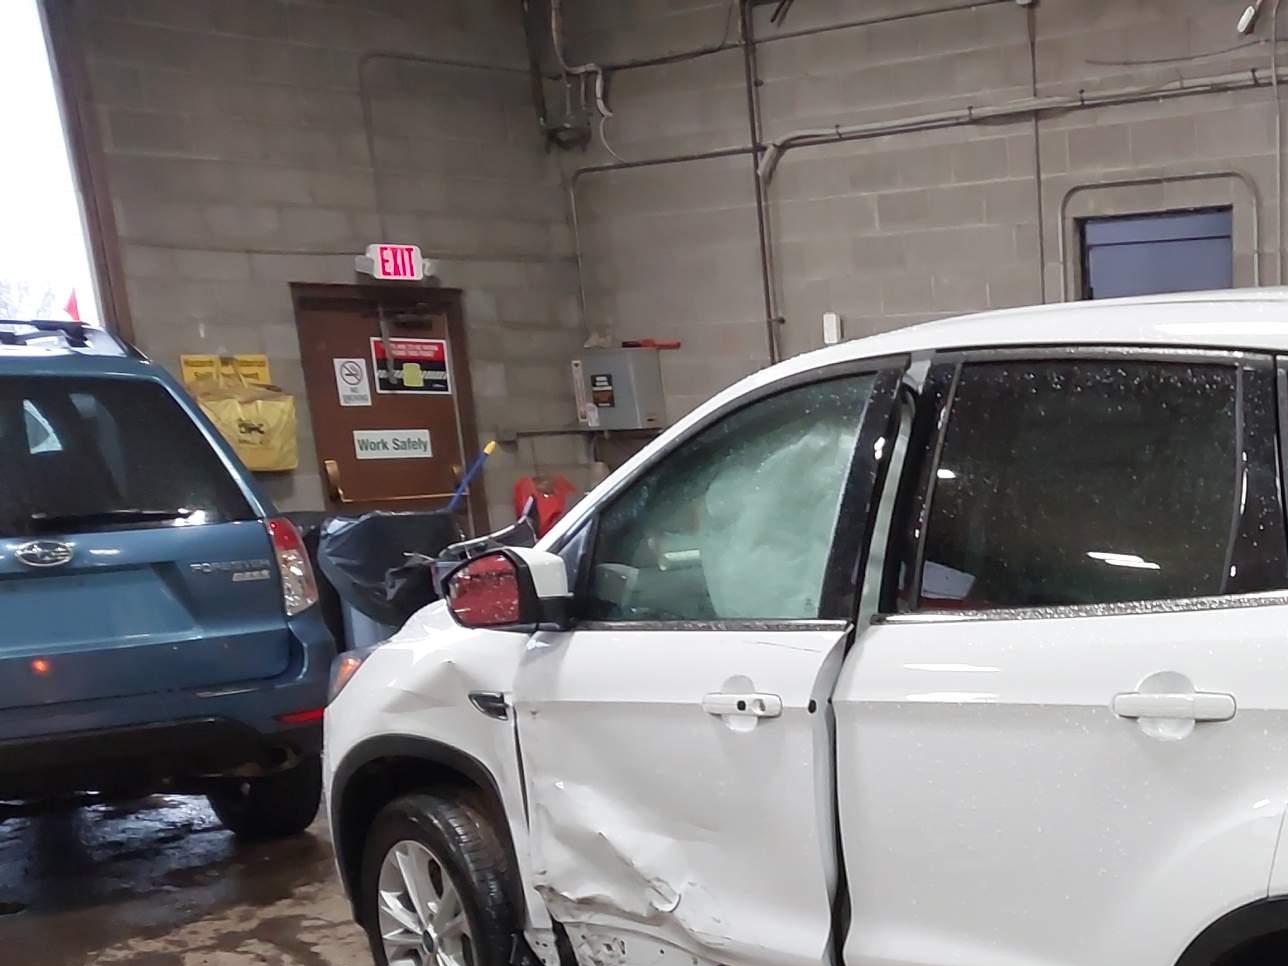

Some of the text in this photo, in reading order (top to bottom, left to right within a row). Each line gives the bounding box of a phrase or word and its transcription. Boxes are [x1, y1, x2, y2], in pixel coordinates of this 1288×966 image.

[380, 246, 415, 277] EXIT
[357, 437, 428, 452] Work Safely
